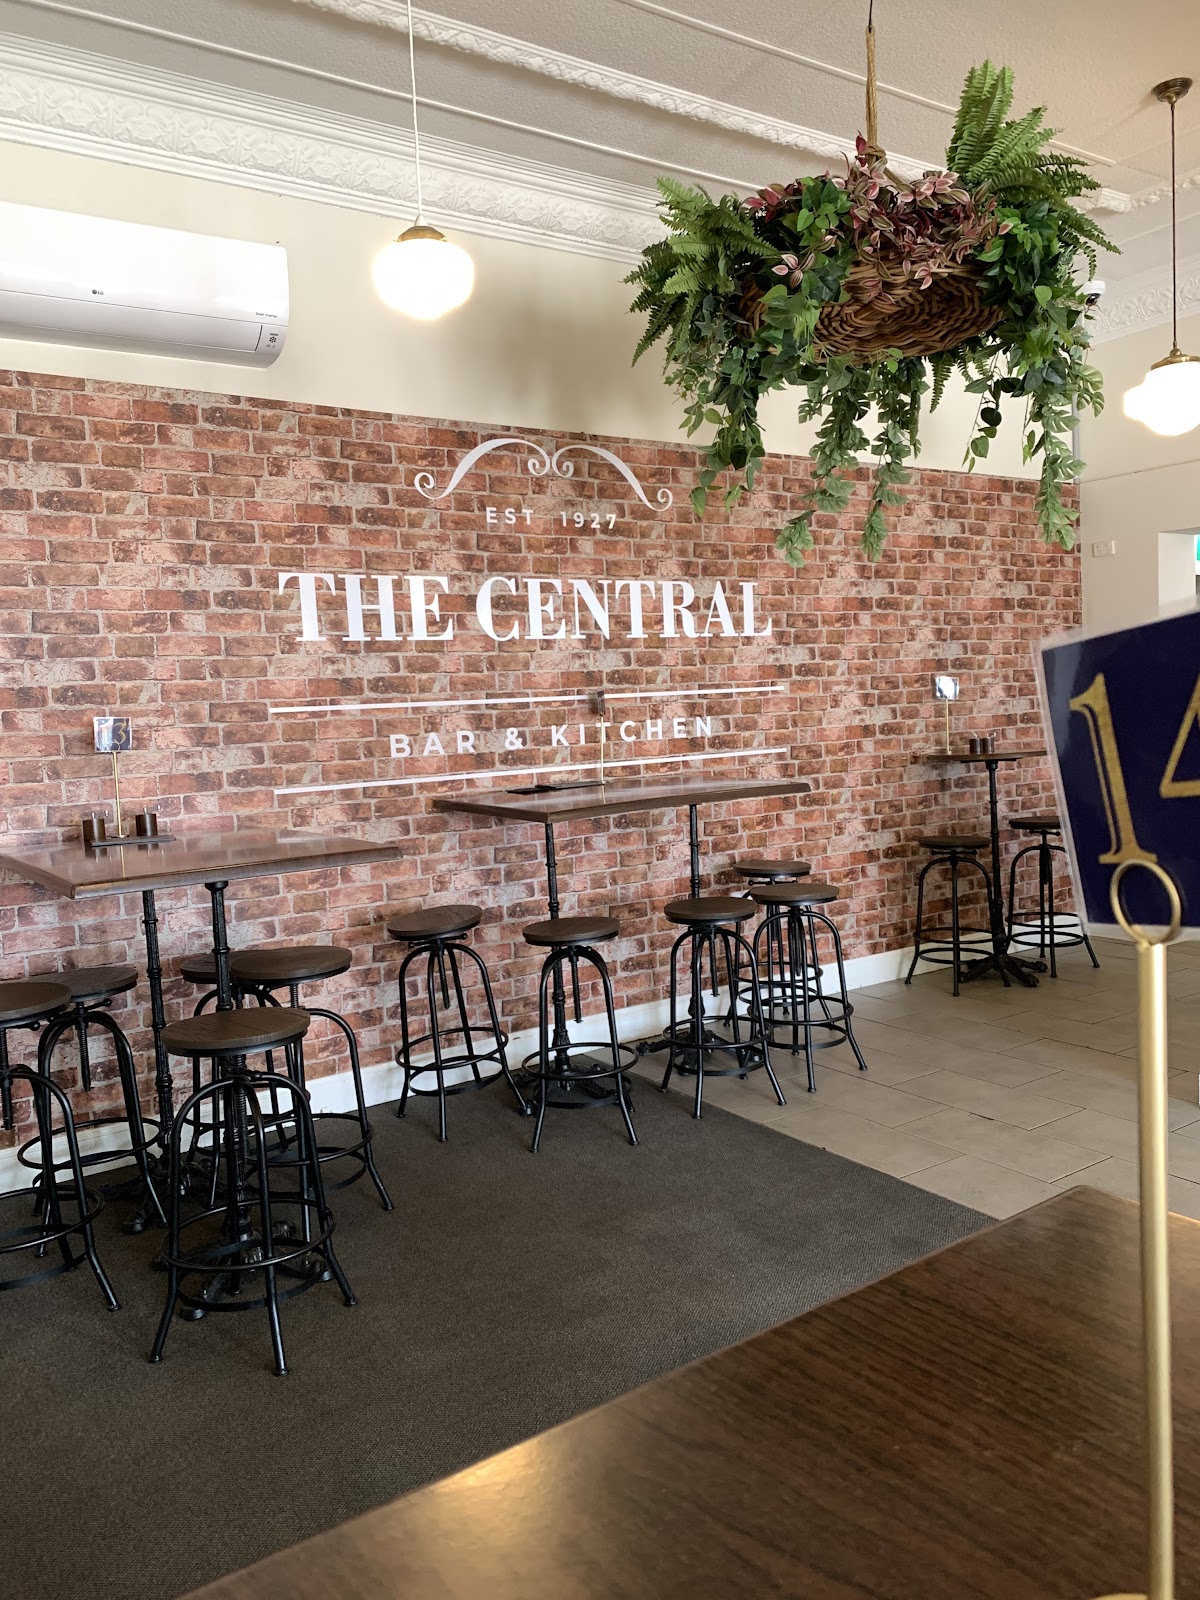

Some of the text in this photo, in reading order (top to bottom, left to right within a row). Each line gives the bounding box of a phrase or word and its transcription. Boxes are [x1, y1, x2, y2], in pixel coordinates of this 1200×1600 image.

[486, 507, 617, 530] EST 1927
[278, 572, 772, 641] THE CENTRAL
[390, 716, 712, 758] BAR & KITCHEN
